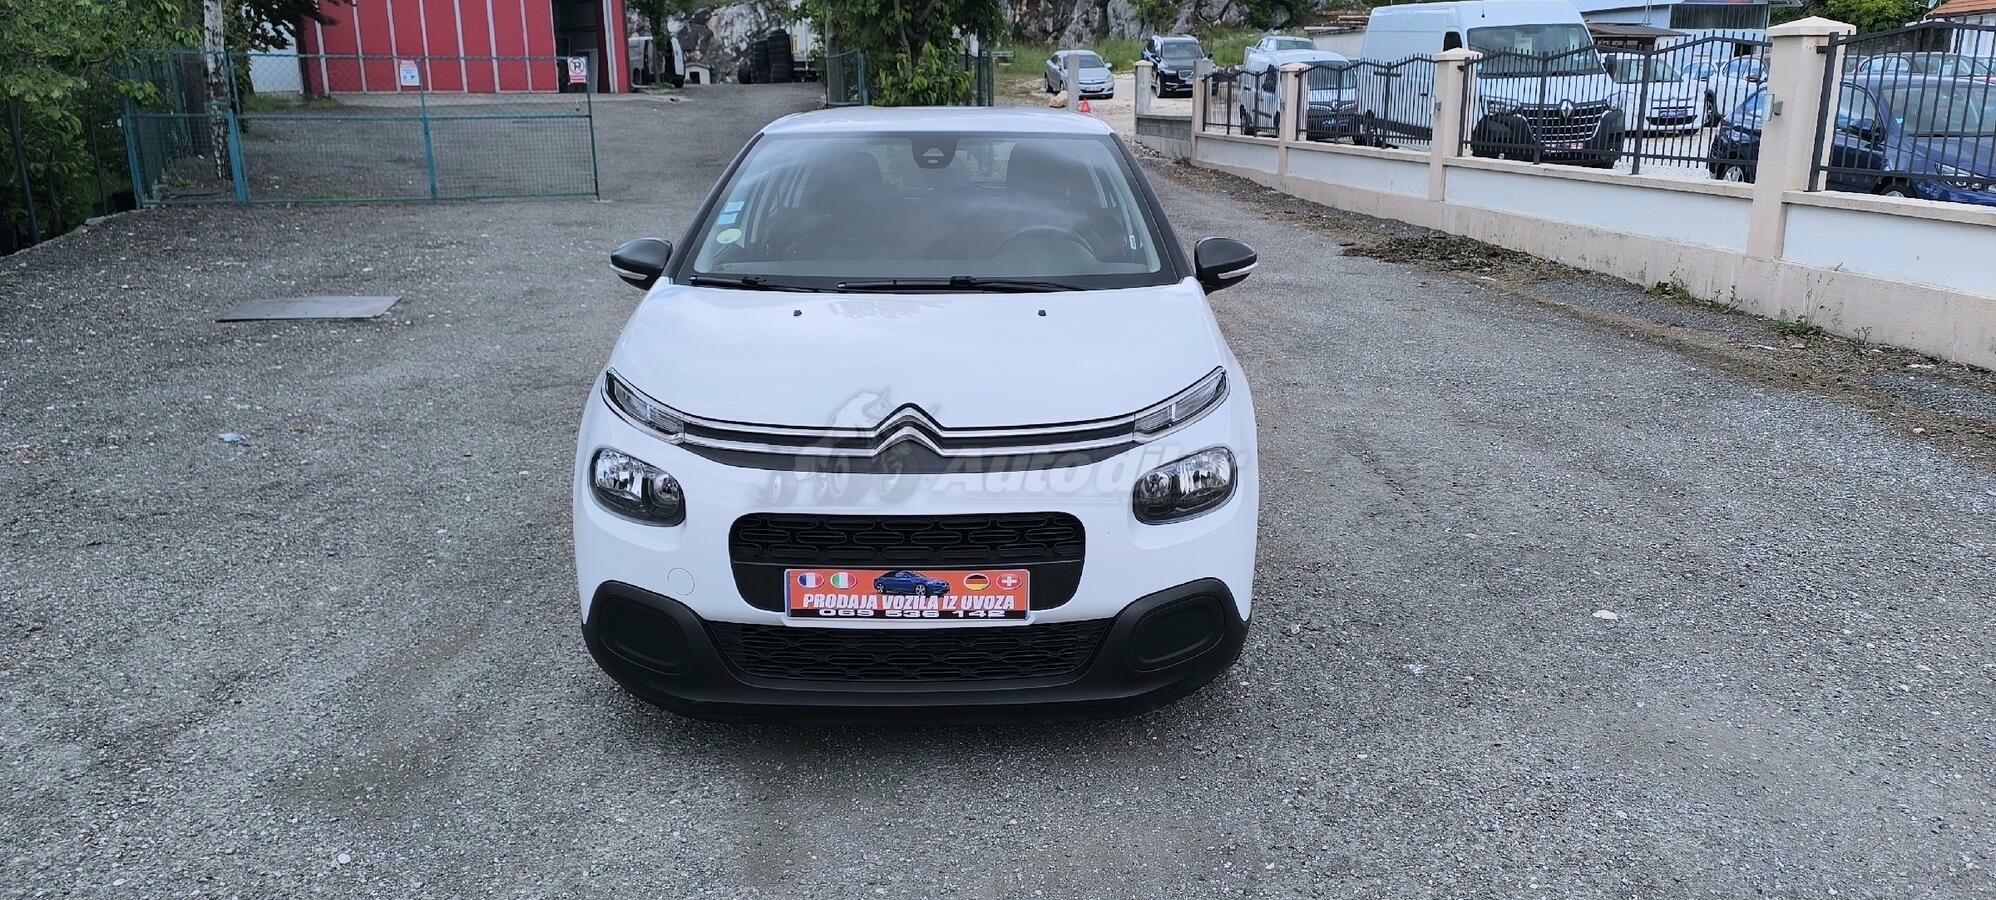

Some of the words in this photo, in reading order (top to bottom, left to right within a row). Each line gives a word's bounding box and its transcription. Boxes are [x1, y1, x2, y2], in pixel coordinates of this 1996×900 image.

[802, 594, 877, 610] PRODAJA
[882, 595, 941, 610] VOZILA
[942, 595, 957, 610] IZ
[961, 595, 1015, 610] UVOZA
[819, 609, 875, 617] 069
[885, 610, 940, 618] 536
[952, 610, 1006, 618] 142
